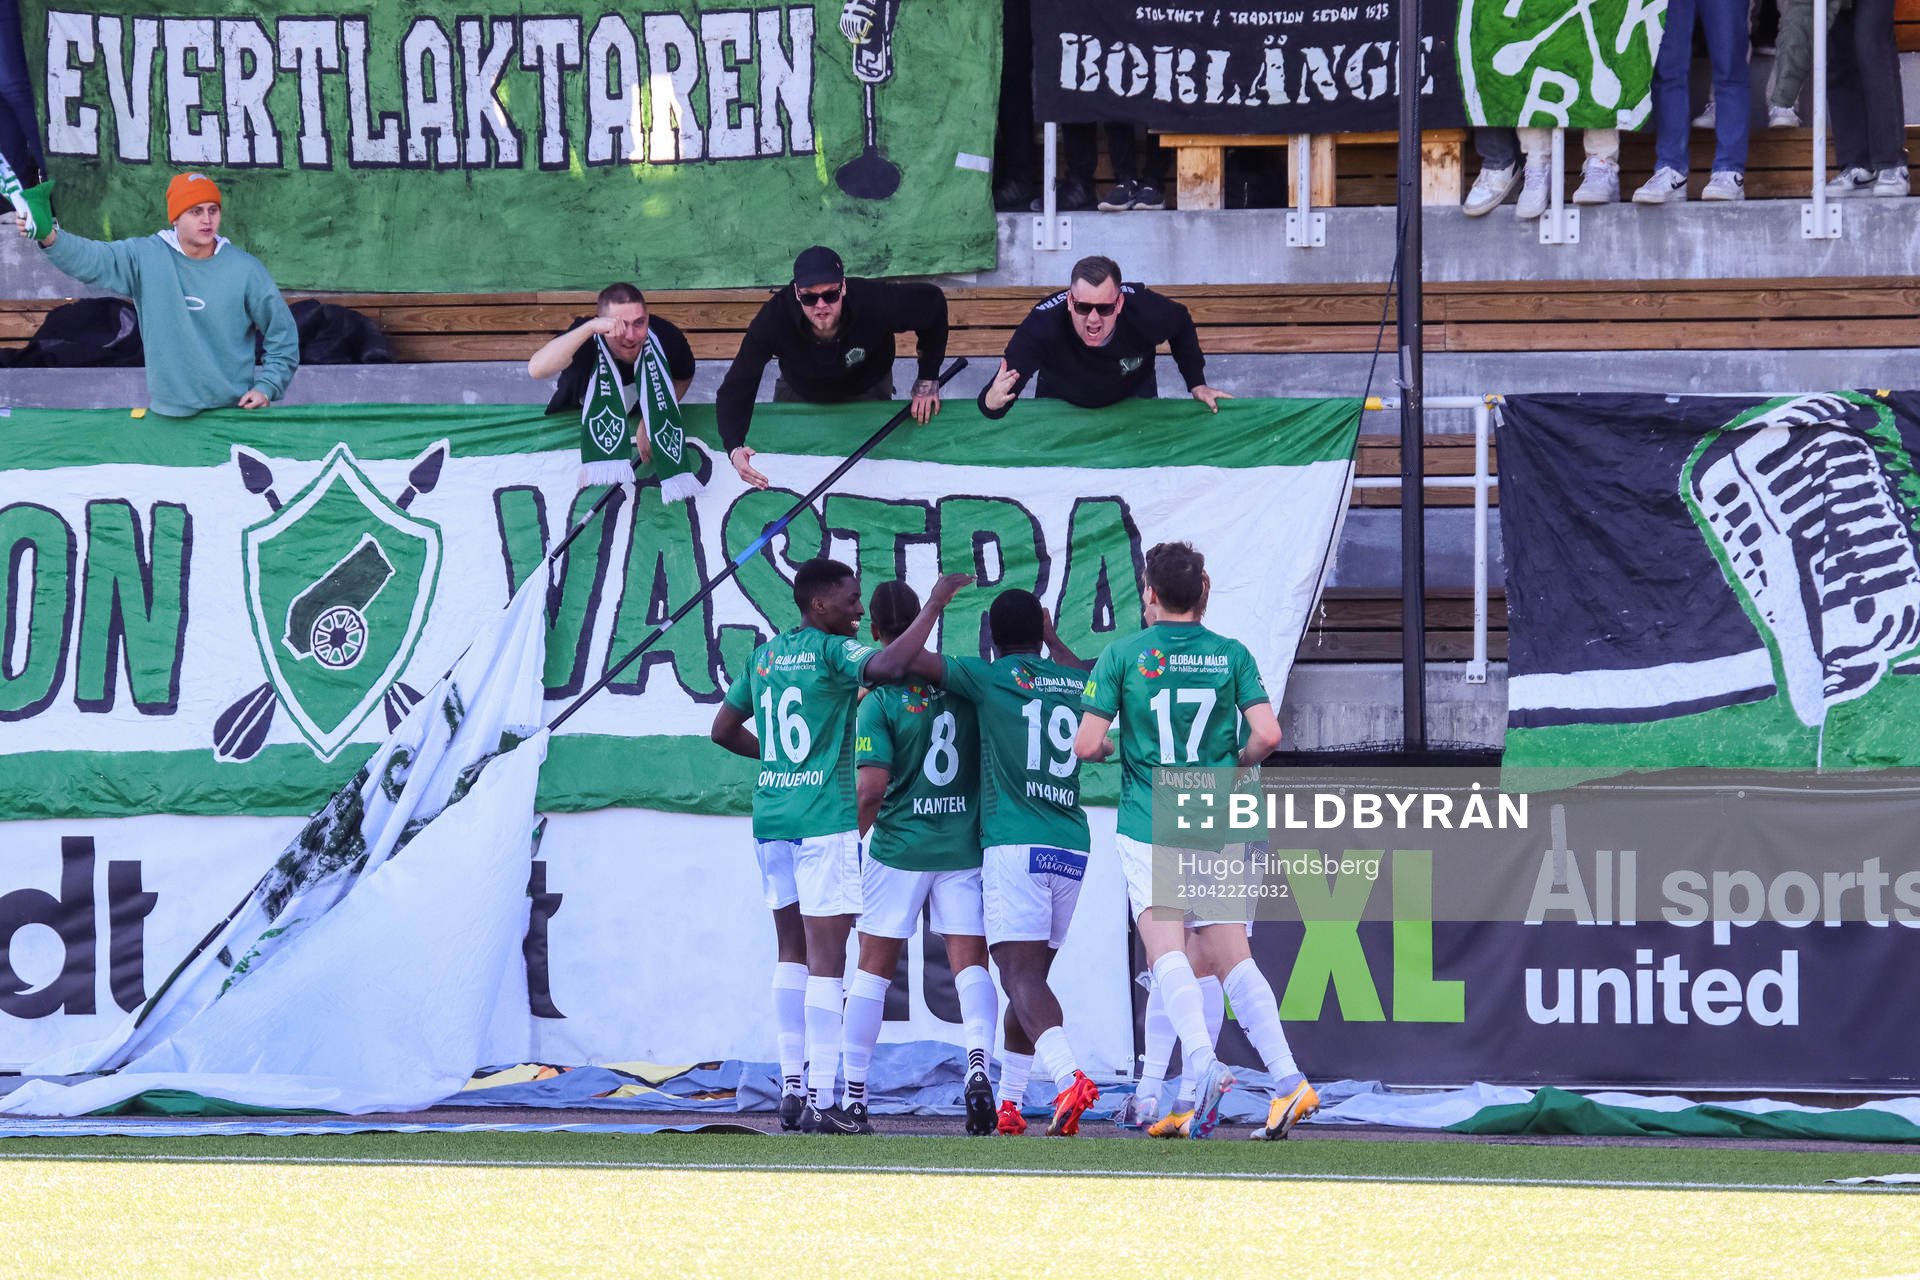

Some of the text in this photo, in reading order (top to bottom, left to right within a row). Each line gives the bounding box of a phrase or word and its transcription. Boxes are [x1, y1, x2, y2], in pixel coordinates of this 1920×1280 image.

[1230, 11, 1304, 25] TRADITION
[1313, 7, 1358, 23] SEDAN
[46, 6, 814, 169] EVERTLAKTAREN
[1036, 291, 1070, 311] STRA
[647, 360, 668, 411] BRAGE
[1170, 654, 1228, 666] GLOBALA MÅLEN
[760, 686, 811, 763] 16
[923, 711, 959, 787] 8
[1022, 699, 1078, 778] 19
[1150, 688, 1217, 764] 17
[913, 796, 966, 814] KANTEH
[1026, 781, 1075, 807] NYARKO
[1159, 769, 1216, 789] JONSSON
[1524, 849, 1920, 945] All sports
[1224, 848, 1465, 1023] XL
[1525, 949, 1799, 1026] united
